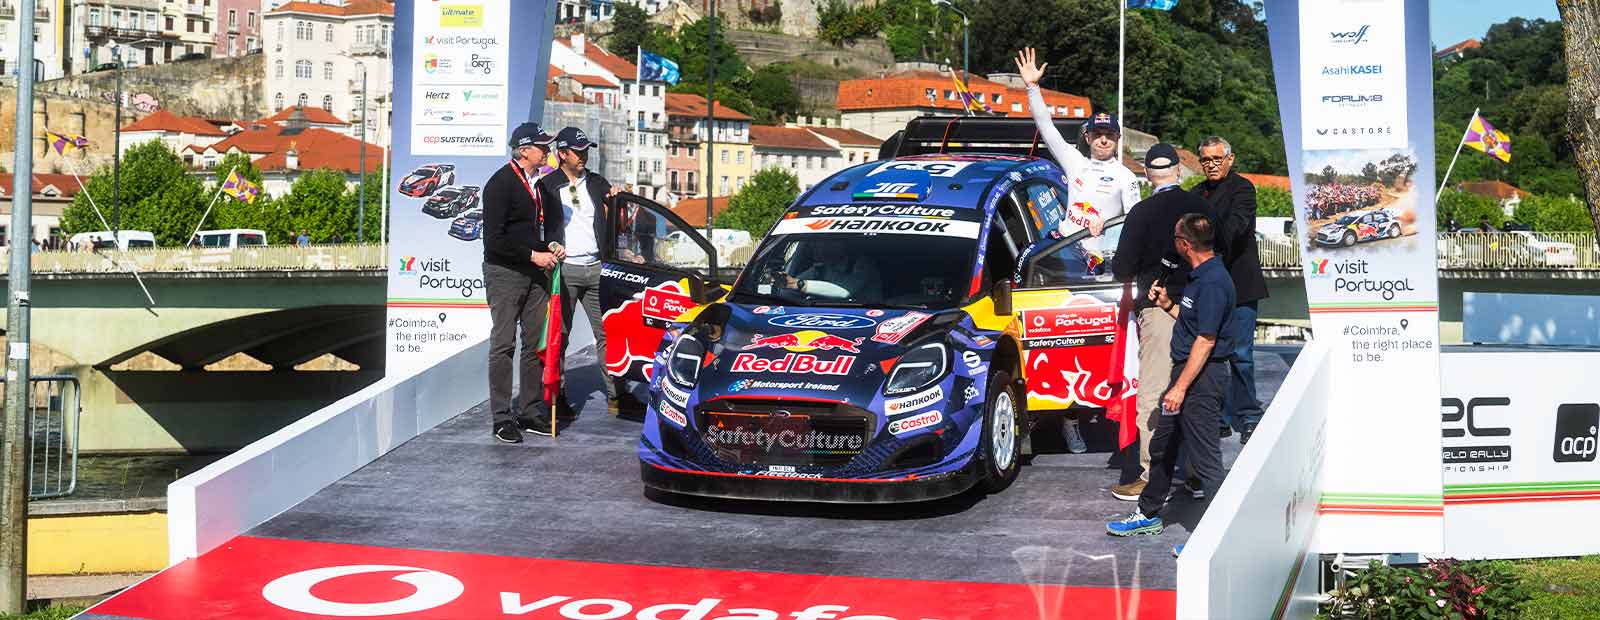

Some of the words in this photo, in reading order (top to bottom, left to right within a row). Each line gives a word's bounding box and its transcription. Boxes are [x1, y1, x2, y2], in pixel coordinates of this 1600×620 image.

[437, 36, 455, 46] visit
[455, 35, 497, 49] Portugal
[1322, 64, 1382, 75] AsahiKASEI
[425, 91, 451, 101] Hertz
[1333, 126, 1391, 136] CASTORE
[811, 205, 955, 218] SafetyCulture
[421, 258, 451, 272] visit
[1334, 258, 1368, 274] visit
[1335, 278, 1414, 300] Portugal
[389, 319, 438, 329] #Coimbra,
[788, 314, 858, 328] Ford
[1055, 316, 1113, 328] Portugal
[1344, 326, 1400, 336] #Coimbra,
[396, 332, 411, 342] the
[414, 332, 436, 343] right
[440, 332, 467, 343] place
[1029, 338, 1086, 348] SafetyCulture
[396, 343, 405, 353] to
[409, 343, 423, 353] be.
[1352, 340, 1369, 350] the
[1373, 340, 1398, 351] right
[1402, 339, 1432, 349] place
[1353, 353, 1362, 362] to
[1366, 353, 1383, 362] be.
[731, 353, 793, 374] Red
[791, 355, 856, 376] Bull
[752, 381, 803, 390] Motorsport
[805, 382, 839, 392] Ireland
[900, 413, 940, 431] Castrol
[706, 425, 862, 453] SafetyCulture
[1470, 449, 1509, 458] RALLY
[1561, 436, 1596, 459] acp
